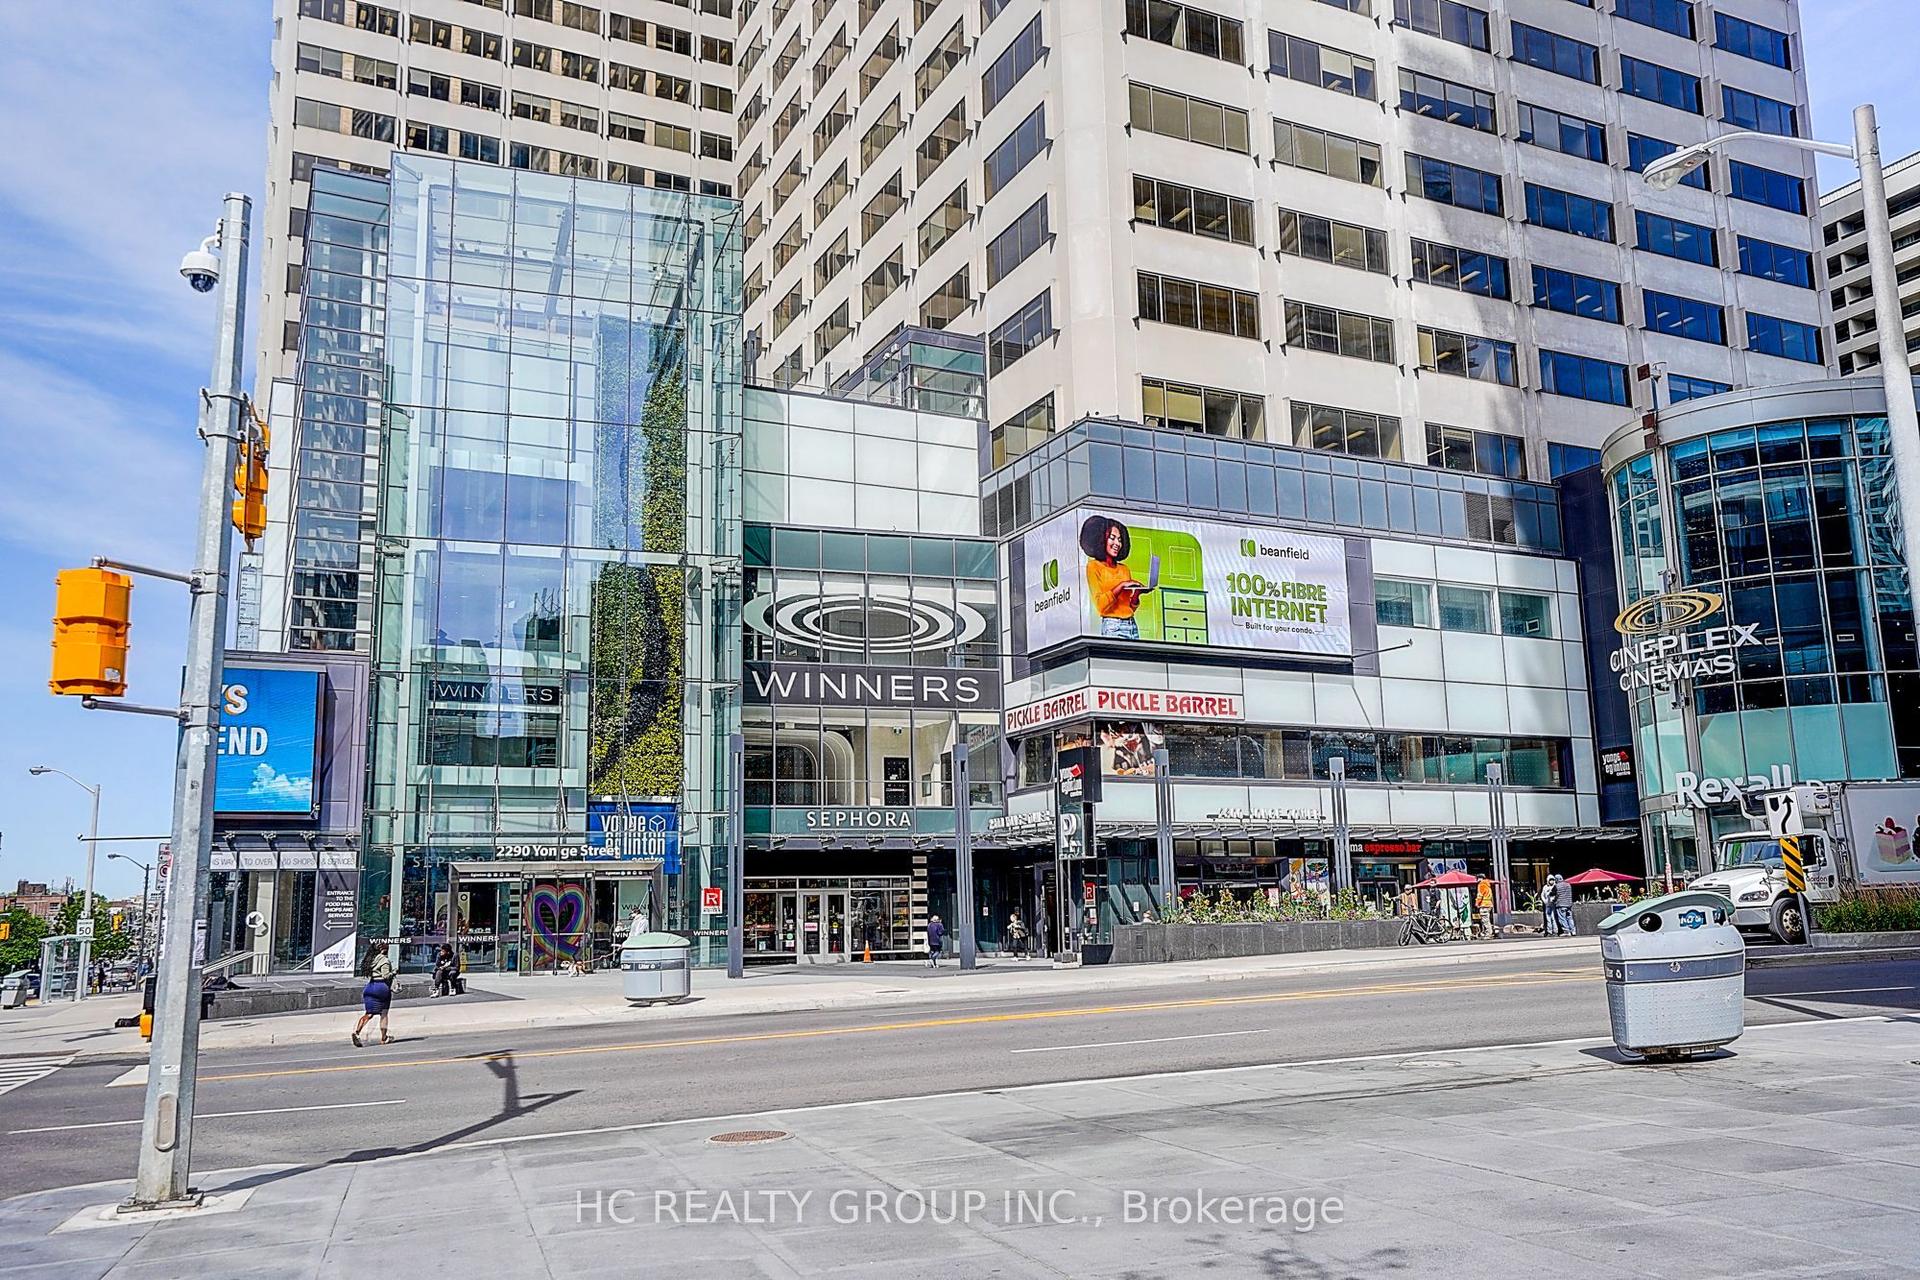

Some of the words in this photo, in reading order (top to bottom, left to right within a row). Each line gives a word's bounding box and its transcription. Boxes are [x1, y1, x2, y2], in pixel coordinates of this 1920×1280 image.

[1260, 544, 1310, 560] beanfield
[1034, 588, 1071, 613] beanfield
[1226, 572, 1281, 598] 100%
[1281, 581, 1327, 602] FIBRE
[1231, 596, 1328, 623] INTERNET
[1245, 622, 1262, 630] Built
[1263, 623, 1273, 631] for
[1274, 625, 1290, 633] your
[1291, 626, 1315, 635] condo.
[1610, 622, 1762, 672] CINEPLEX
[752, 670, 981, 703] WINNERS
[1619, 655, 1736, 691] CINEMAS
[438, 683, 553, 702] WINNERS
[1097, 690, 1160, 711] PICKLE
[1165, 695, 1238, 717] BARREL
[1007, 706, 1041, 730] PICKLE
[1043, 692, 1088, 721] BARREL
[1675, 764, 1793, 809] Rexall
[807, 811, 911, 828] SEPHORA
[496, 846, 530, 857] 2290
[580, 845, 620, 858] Street
[79, 926, 91, 935] 50
